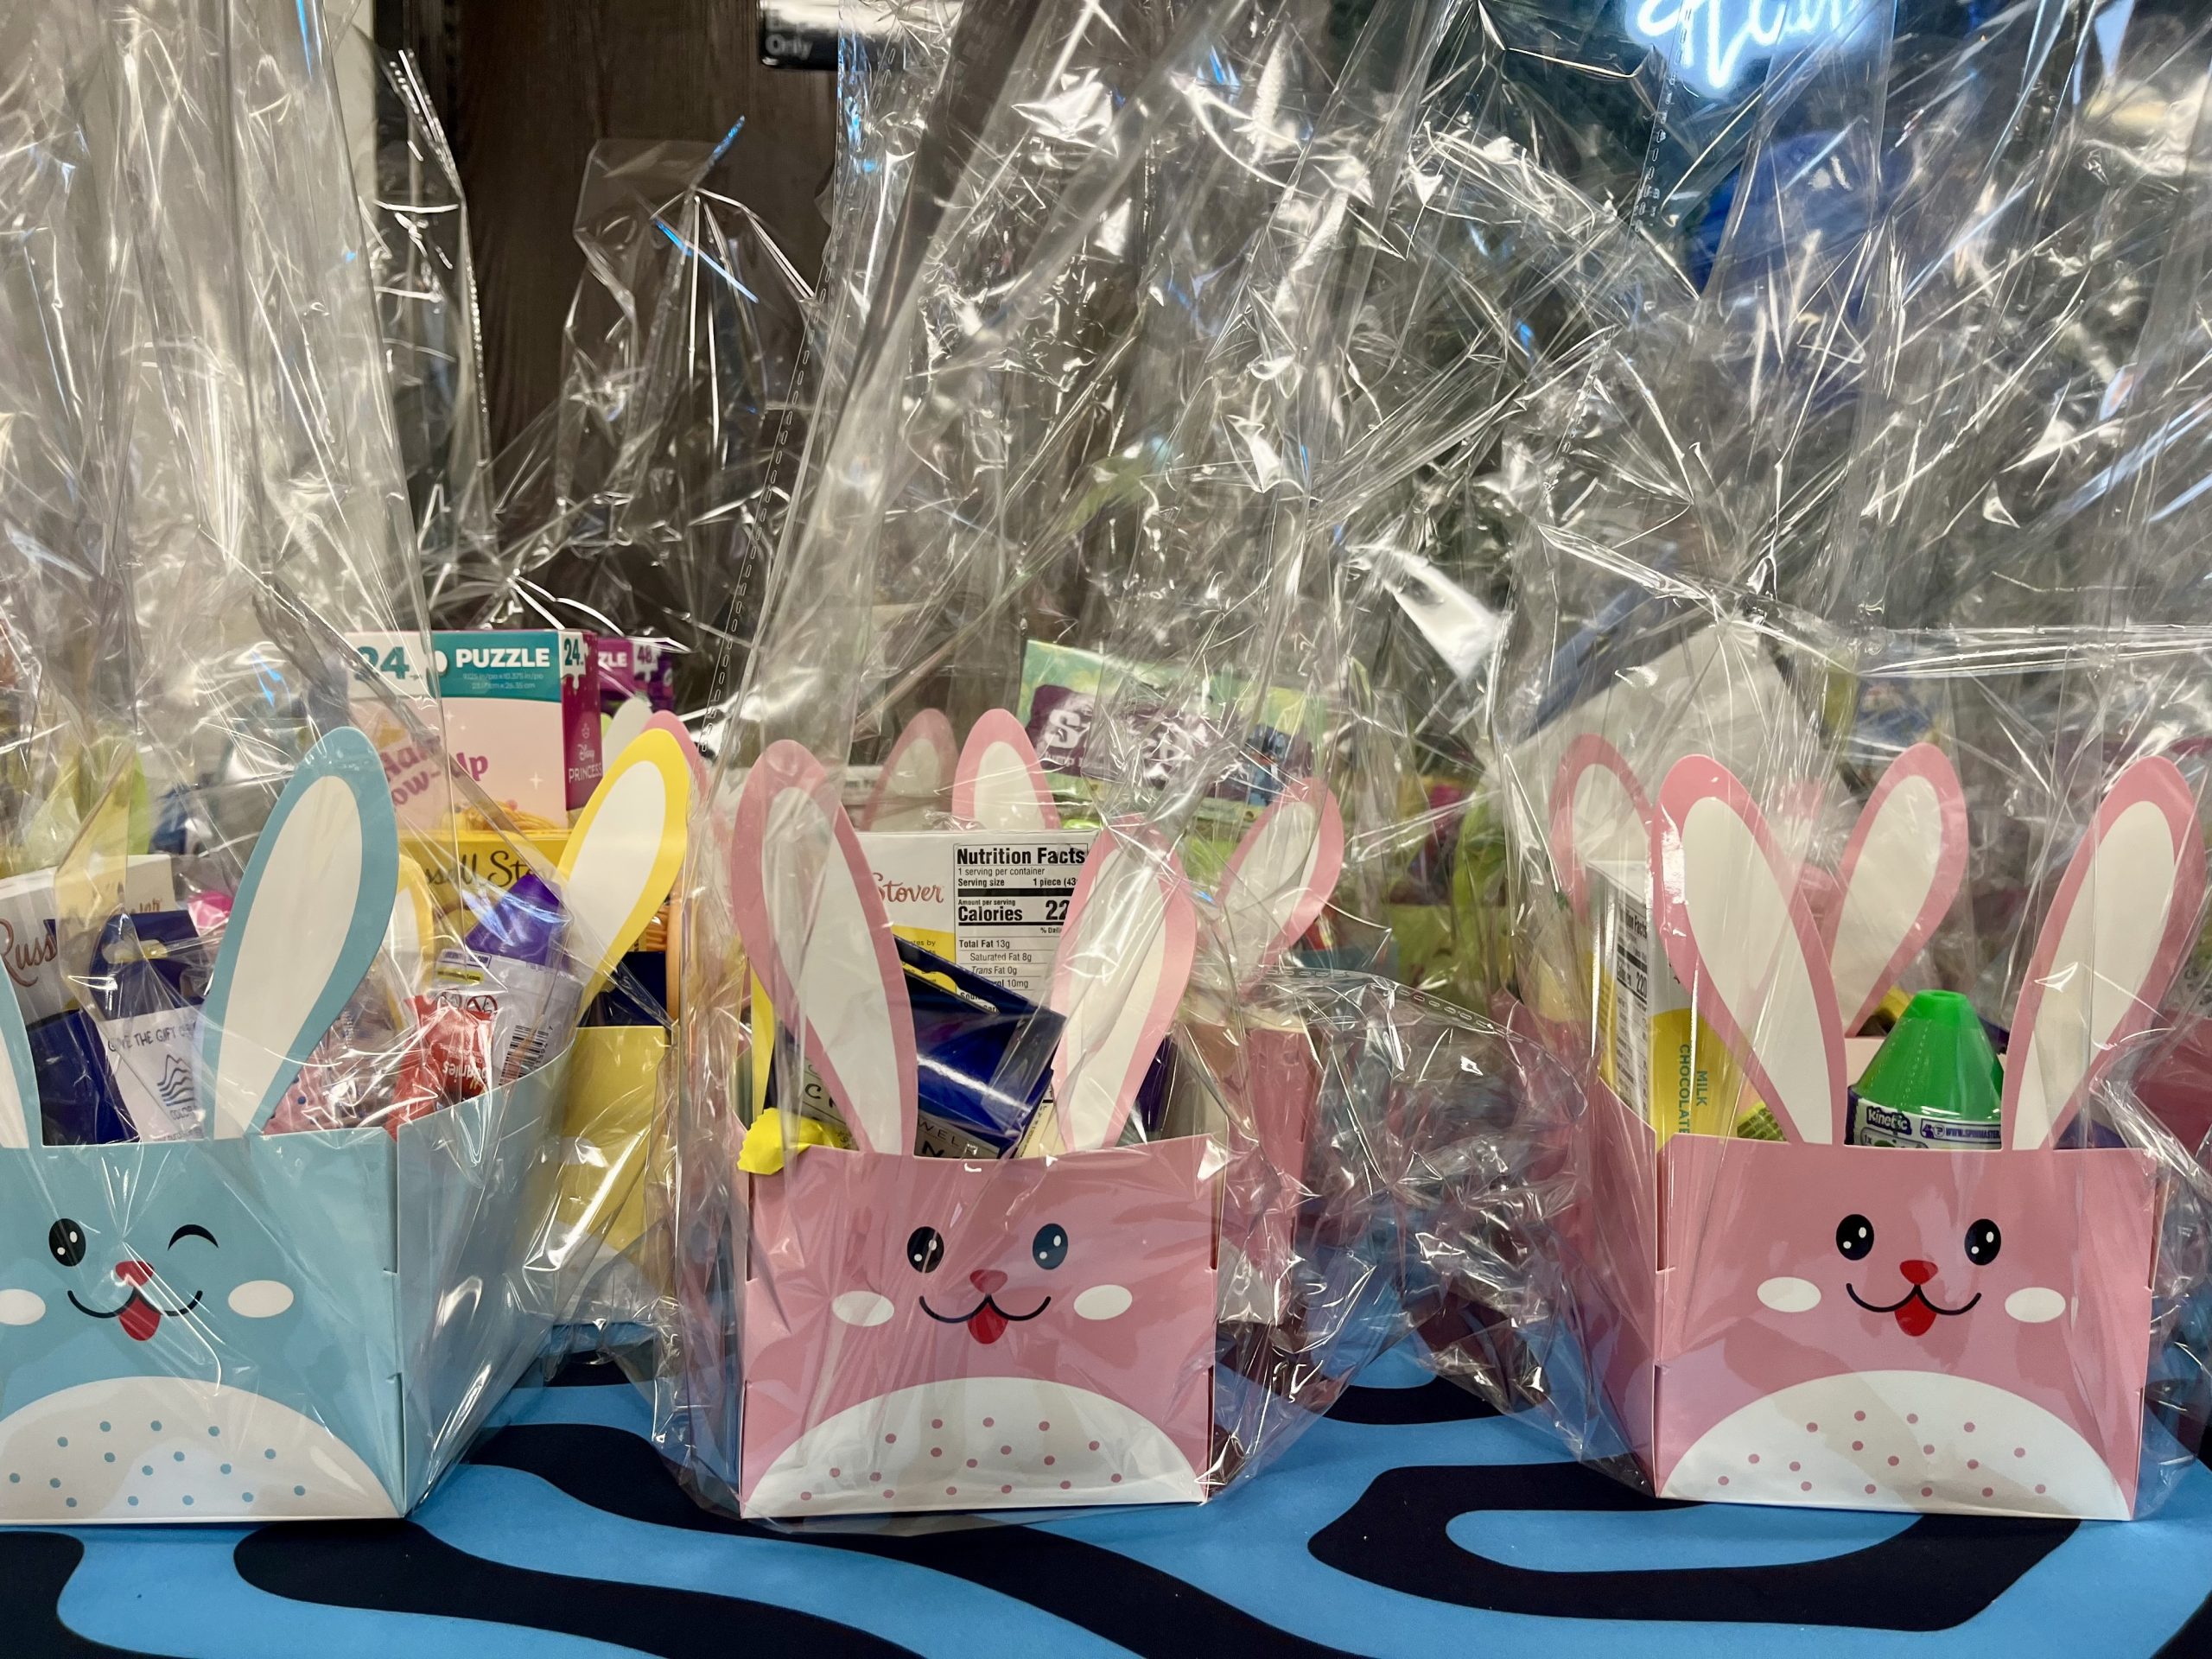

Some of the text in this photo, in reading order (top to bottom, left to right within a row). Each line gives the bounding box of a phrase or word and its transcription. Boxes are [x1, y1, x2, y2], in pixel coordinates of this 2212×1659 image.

[455, 647, 550, 668] PUZZLE
[563, 638, 581, 666] 24
[598, 652, 628, 668] ZLE
[568, 762, 604, 785] PRINCESS
[957, 847, 1086, 865] Nutrition Facts
[957, 878, 988, 888] Serving
[989, 878, 1005, 887] size
[1039, 878, 1062, 887] piece
[1064, 878, 1078, 887] (43
[965, 868, 993, 877] serving
[995, 868, 1008, 877] per
[1009, 868, 1046, 876] container
[957, 899, 1071, 922] Calories 22
[0, 918, 57, 988] Russ
[959, 939, 1010, 949] Total Fat 13g
[970, 953, 1033, 963] Saturated Fat 8g
[971, 966, 993, 975] Trans
[1007, 979, 1029, 988] 10mg
[135, 1030, 154, 1047] THE
[156, 1026, 176, 1043] GIFT
[1679, 1044, 1691, 1135] CHOCOLATE
[1696, 1070, 1708, 1107] MILK
[1867, 1109, 1909, 1131] Kinetic
